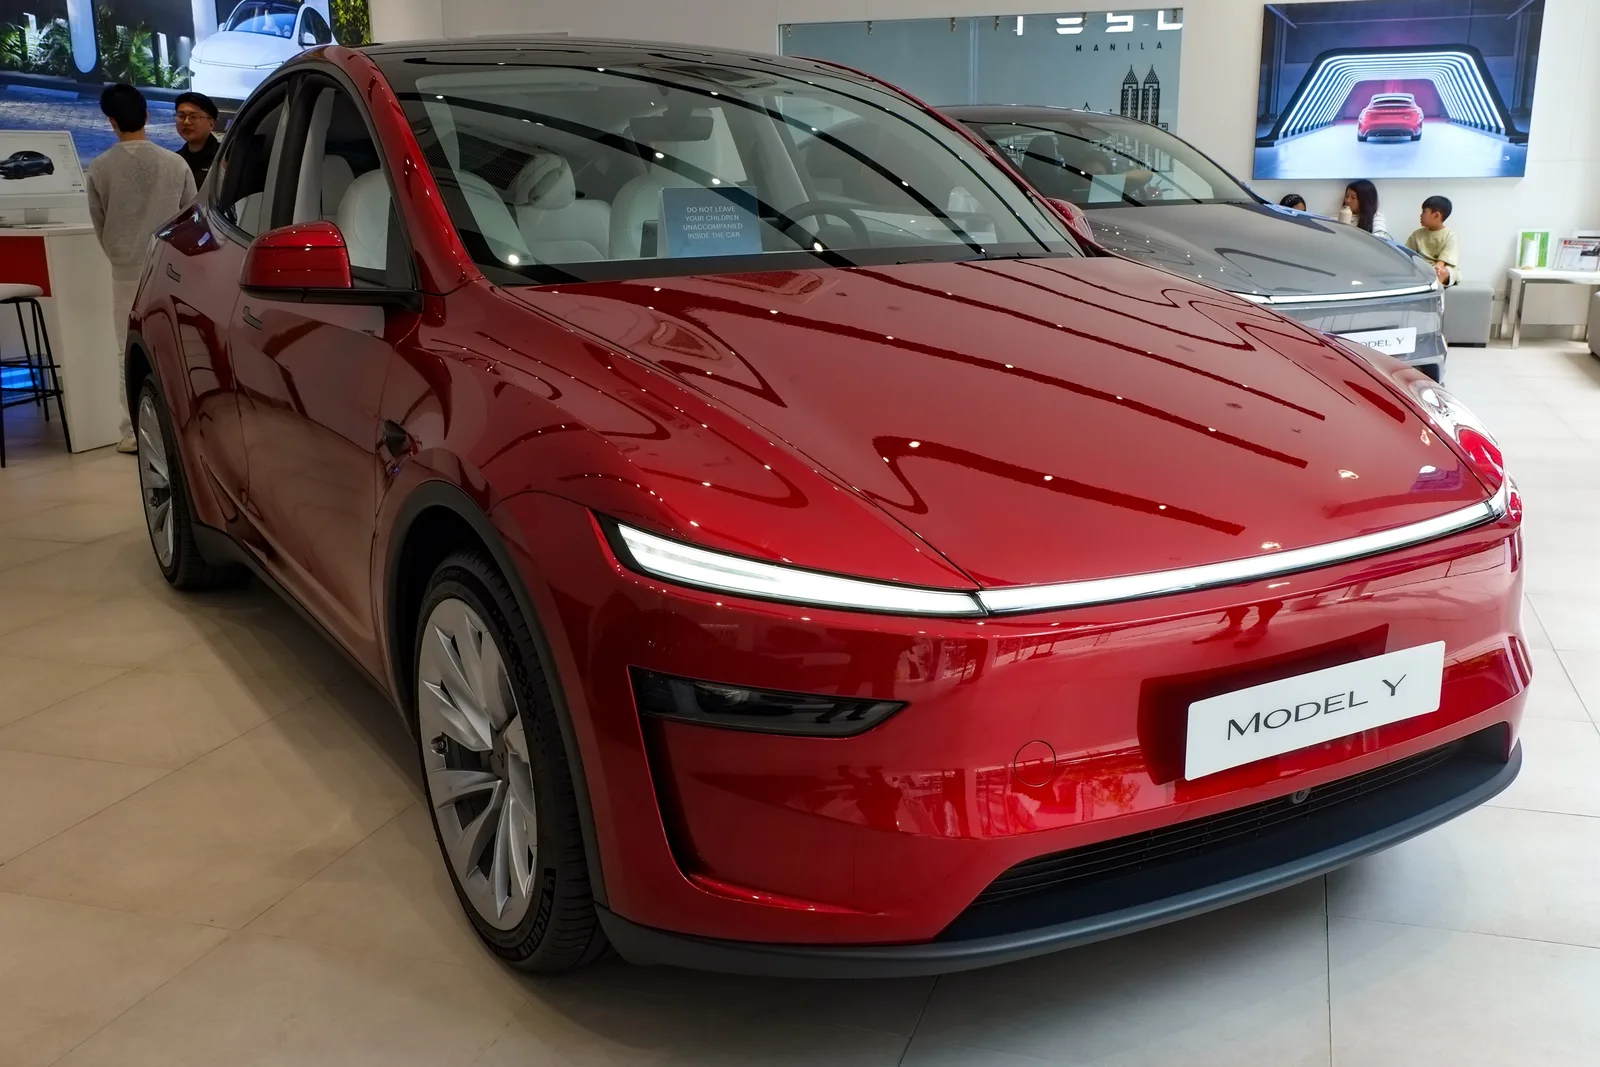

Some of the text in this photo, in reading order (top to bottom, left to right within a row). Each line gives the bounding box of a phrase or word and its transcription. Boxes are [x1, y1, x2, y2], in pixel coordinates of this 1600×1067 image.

[1075, 41, 1163, 52] MANILA
[714, 205, 736, 213] LEAVE
[683, 223, 743, 231] UNACCOMPANIED
[1360, 336, 1405, 348] ODEL Y
[1227, 673, 1407, 741] MODEL Y
[518, 892, 553, 957] MICHELIN
